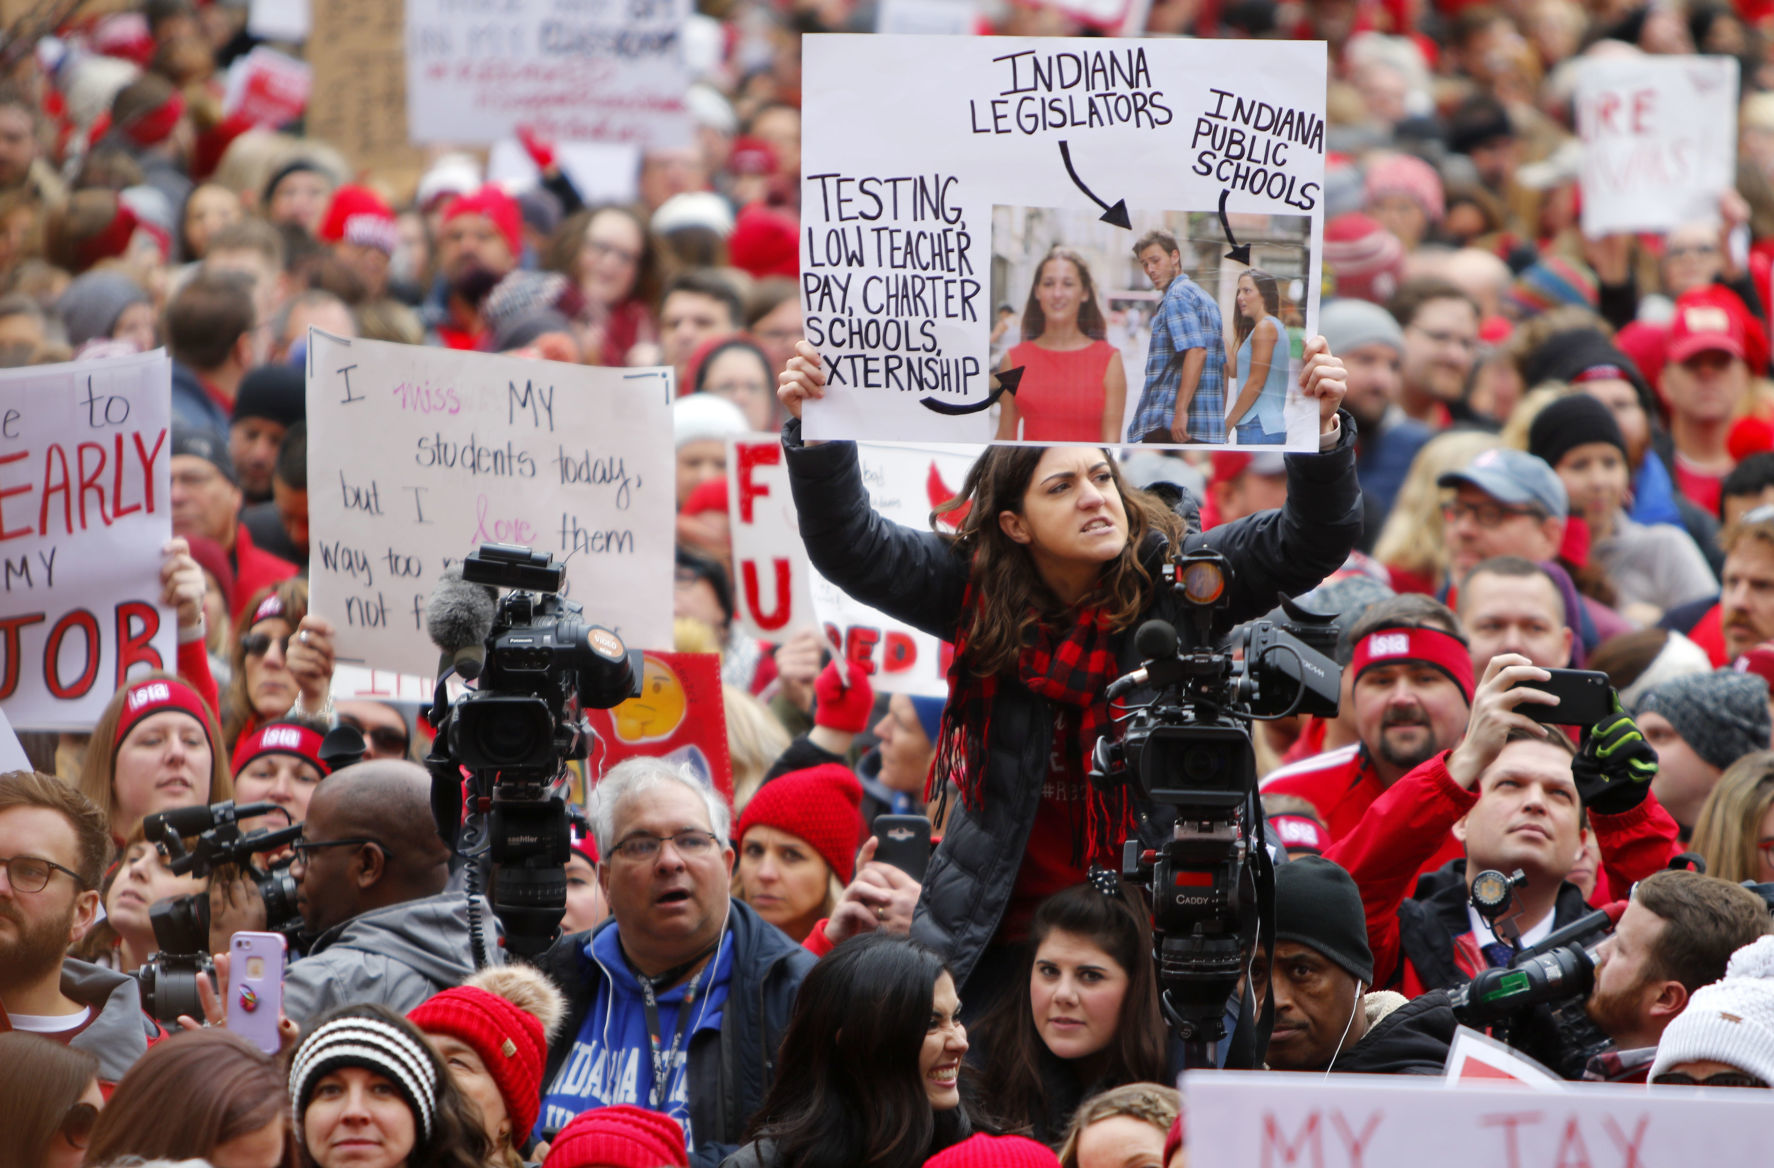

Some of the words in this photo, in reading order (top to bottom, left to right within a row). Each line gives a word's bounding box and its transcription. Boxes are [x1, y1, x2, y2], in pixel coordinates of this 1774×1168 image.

[992, 47, 1152, 96] INDIANA
[970, 91, 1173, 135] LEGISLATORS
[1204, 88, 1324, 154] INDIANA
[1191, 117, 1289, 167] PUBLIC
[807, 173, 967, 231] TESTING,
[1191, 150, 1321, 211] SCHOOLS
[808, 226, 865, 268] LOW
[871, 226, 974, 277] TEACHER
[803, 272, 853, 317] PAY,
[862, 274, 982, 323] CHARTER
[806, 316, 942, 357] SCHOOLS,
[336, 364, 366, 405] I
[816, 352, 981, 395] XTERNSHIP
[80, 374, 130, 428] to
[415, 431, 536, 478] students
[552, 444, 642, 510] today,
[339, 468, 384, 516] but
[401, 486, 435, 525] I
[472, 493, 537, 547] love
[556, 512, 634, 554] them
[5, 545, 57, 591] MY
[382, 547, 422, 578] too
[345, 591, 392, 628] not
[0, 600, 164, 700] JOB
[1259, 1108, 1387, 1168] MY
[1475, 1108, 1653, 1168] TAX
